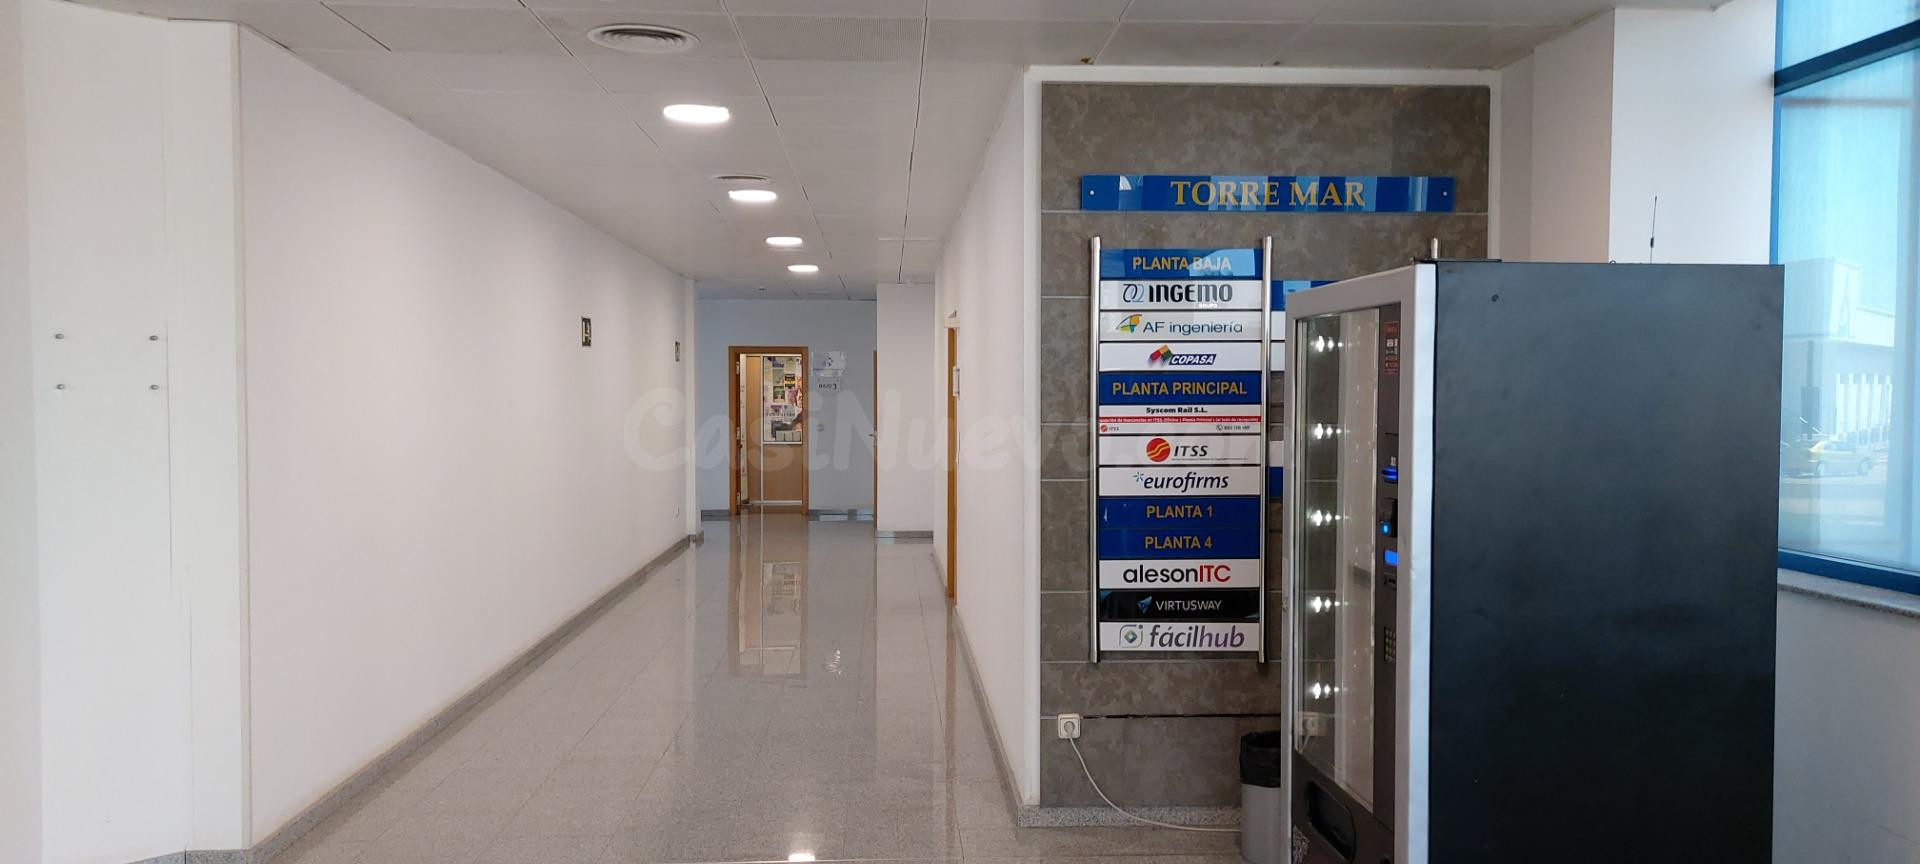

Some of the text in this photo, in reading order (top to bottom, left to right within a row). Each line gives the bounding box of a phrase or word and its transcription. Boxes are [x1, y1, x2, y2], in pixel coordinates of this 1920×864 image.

[1170, 181, 1366, 207] TORRE MAR
[1132, 256, 1232, 271] PLANTA BAJA
[1149, 284, 1233, 303] INGEMO
[1142, 320, 1243, 336] AF ingeniería
[1171, 355, 1215, 366] COPASA
[1112, 381, 1247, 396] PLANTA PRINCIPAL
[1146, 407, 1176, 415] Syscom
[1174, 445, 1208, 457] ITSS
[1144, 472, 1229, 493] eurofirms
[1146, 505, 1213, 519] PLANTA 1
[1145, 536, 1213, 549] PLANTA 4
[1123, 564, 1232, 583] alesonITC
[1156, 600, 1222, 611] VIRTUSWAY
[1149, 625, 1245, 648] fácilhub
